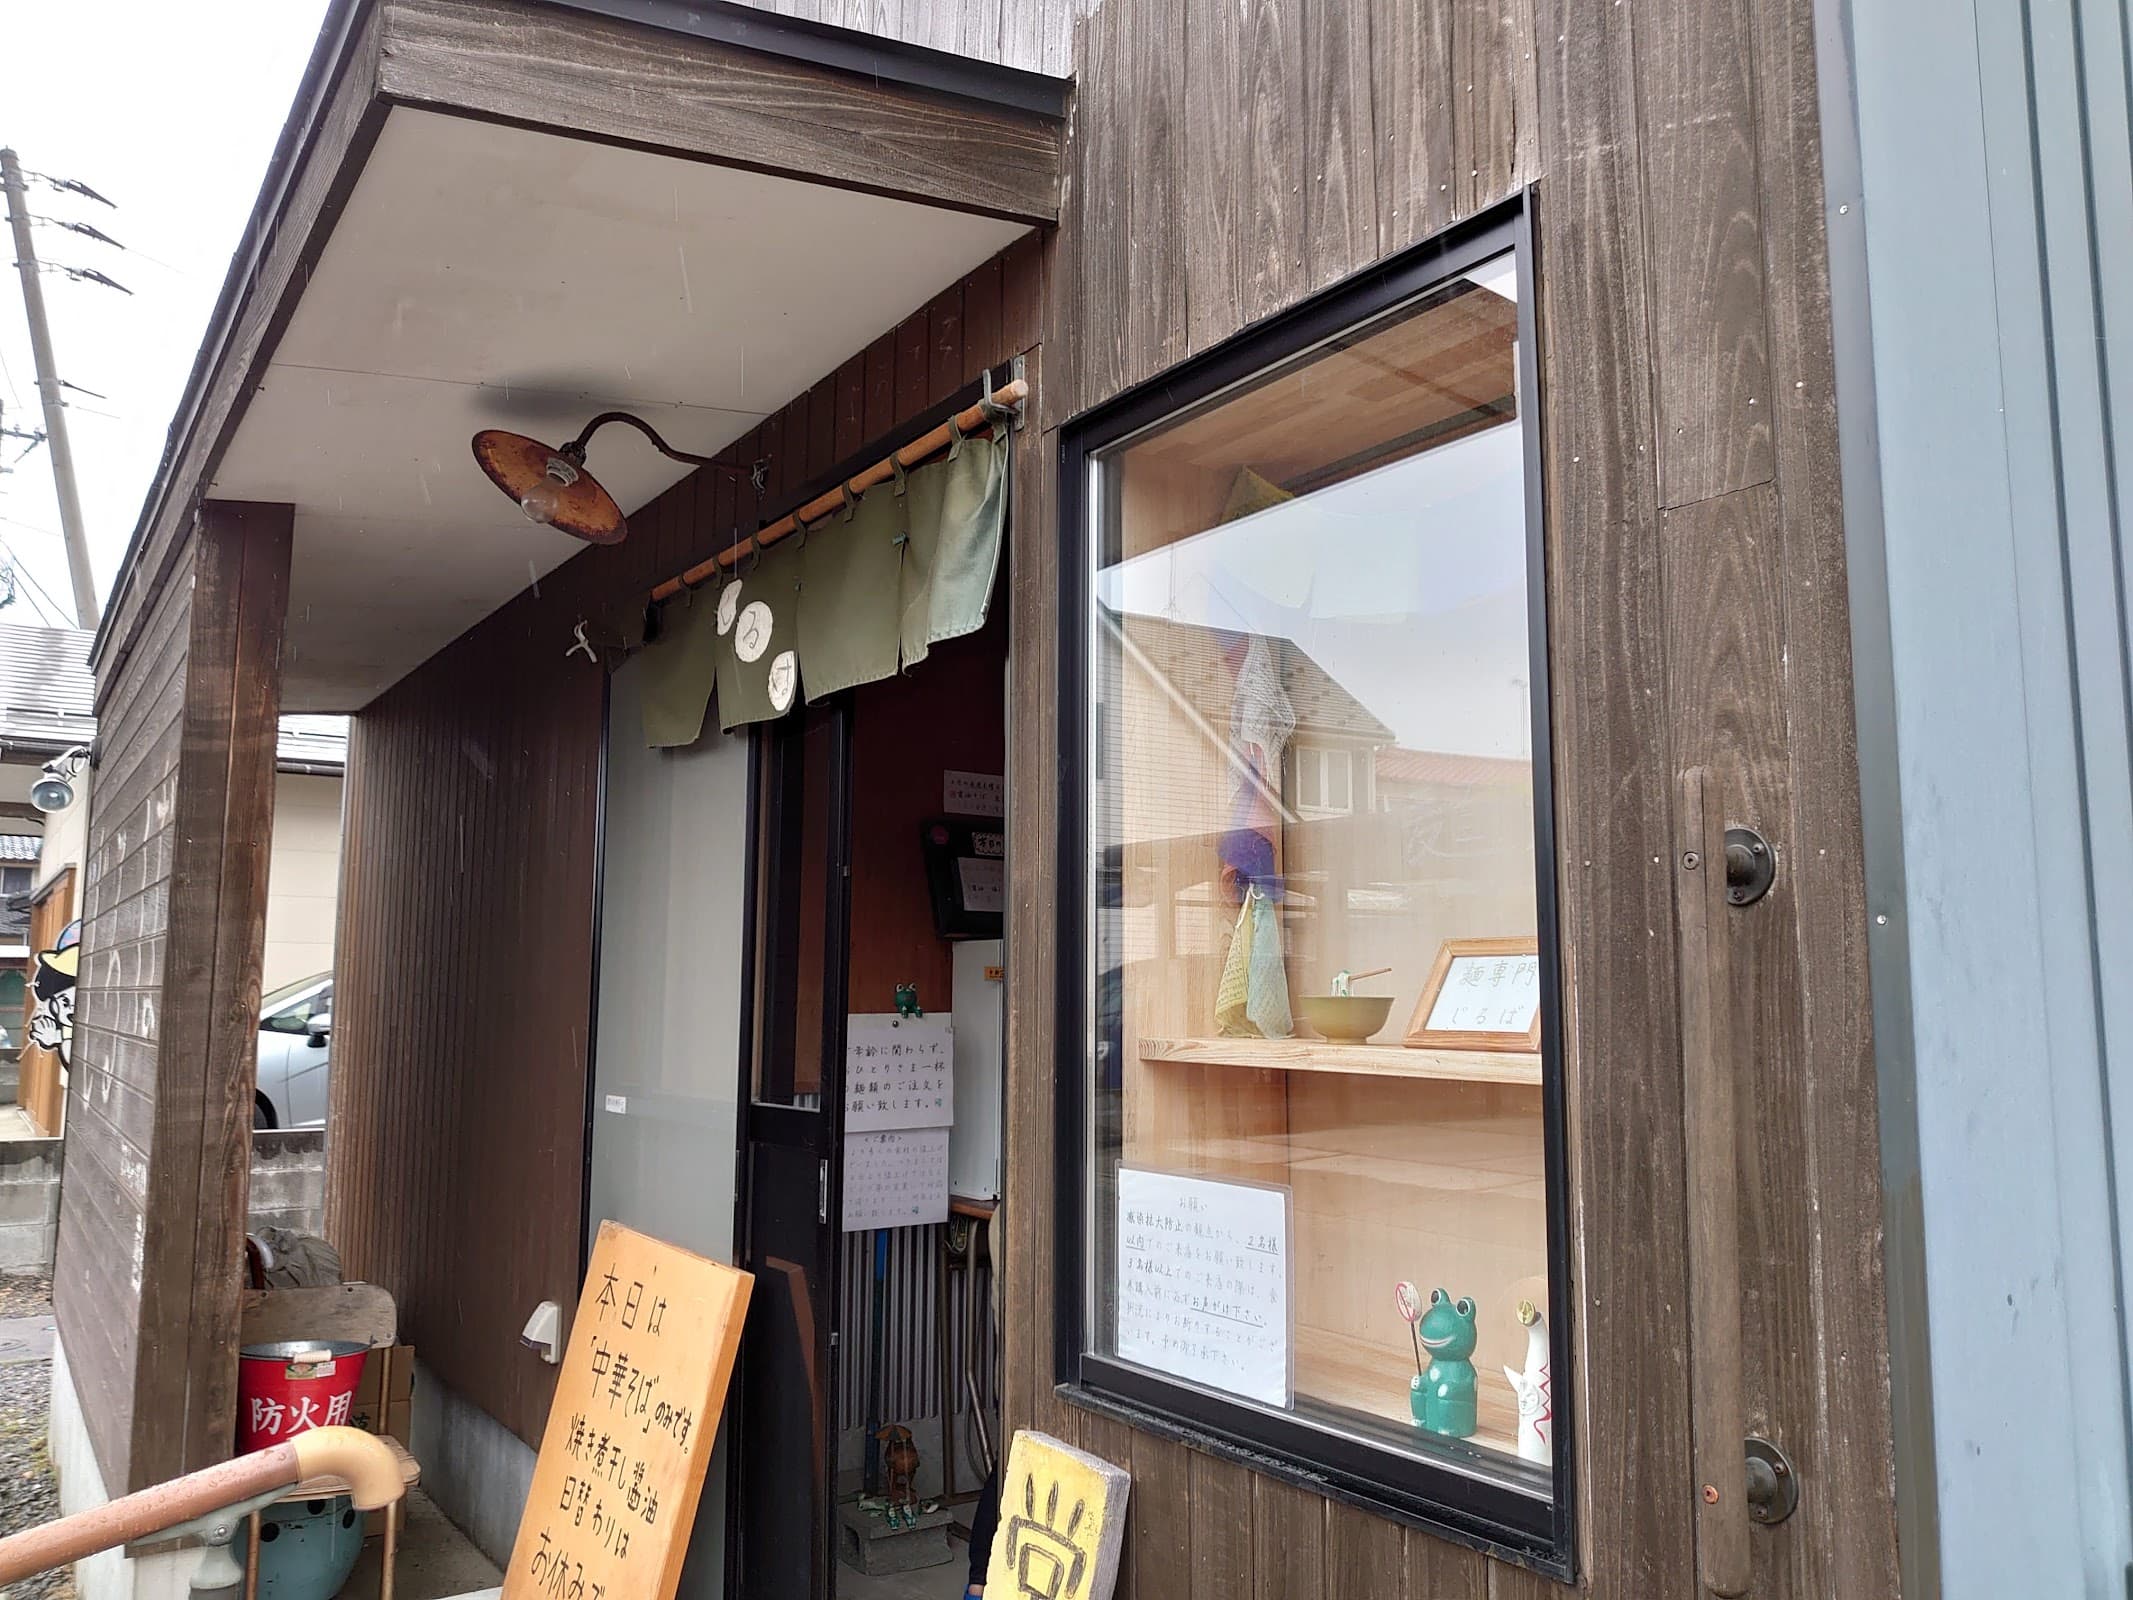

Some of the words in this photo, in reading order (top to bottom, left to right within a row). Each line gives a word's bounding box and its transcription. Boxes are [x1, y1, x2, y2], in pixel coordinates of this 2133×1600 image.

[847, 1042, 945, 1058] 年齢に関わらず、
[595, 1263, 667, 1336] 本日は
[250, 1390, 353, 1436] 防火用
[560, 1475, 632, 1560] 日替わりは
